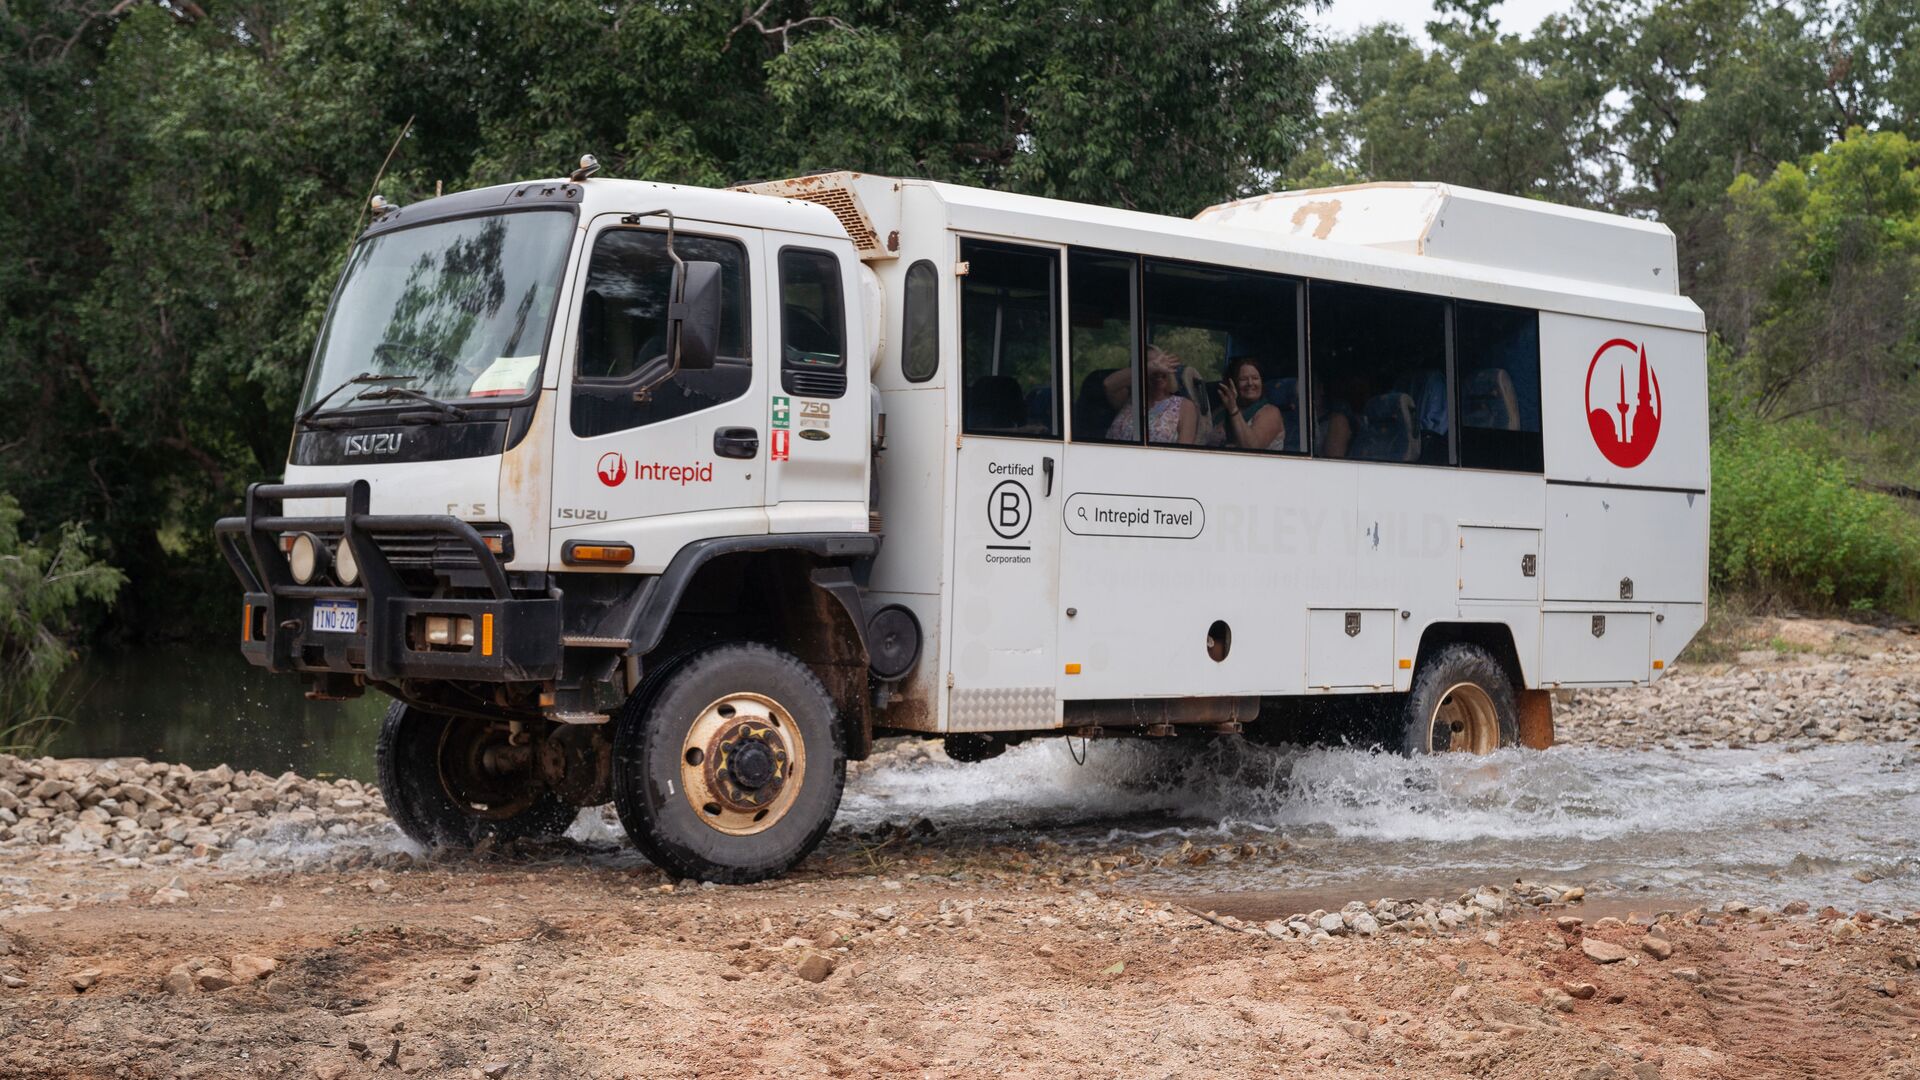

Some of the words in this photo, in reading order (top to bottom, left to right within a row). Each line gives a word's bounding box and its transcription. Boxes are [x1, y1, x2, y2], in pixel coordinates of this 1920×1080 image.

[801, 401, 830, 413] 750
[344, 432, 401, 456] ISUZU
[634, 461, 713, 486] Intrepid
[988, 462, 1034, 476] Certified
[557, 508, 608, 520] ISUZU
[999, 491, 1021, 527] B
[1094, 507, 1149, 527] Intrepid
[1153, 509, 1193, 526] Travel
[985, 553, 1031, 564] Corporation
